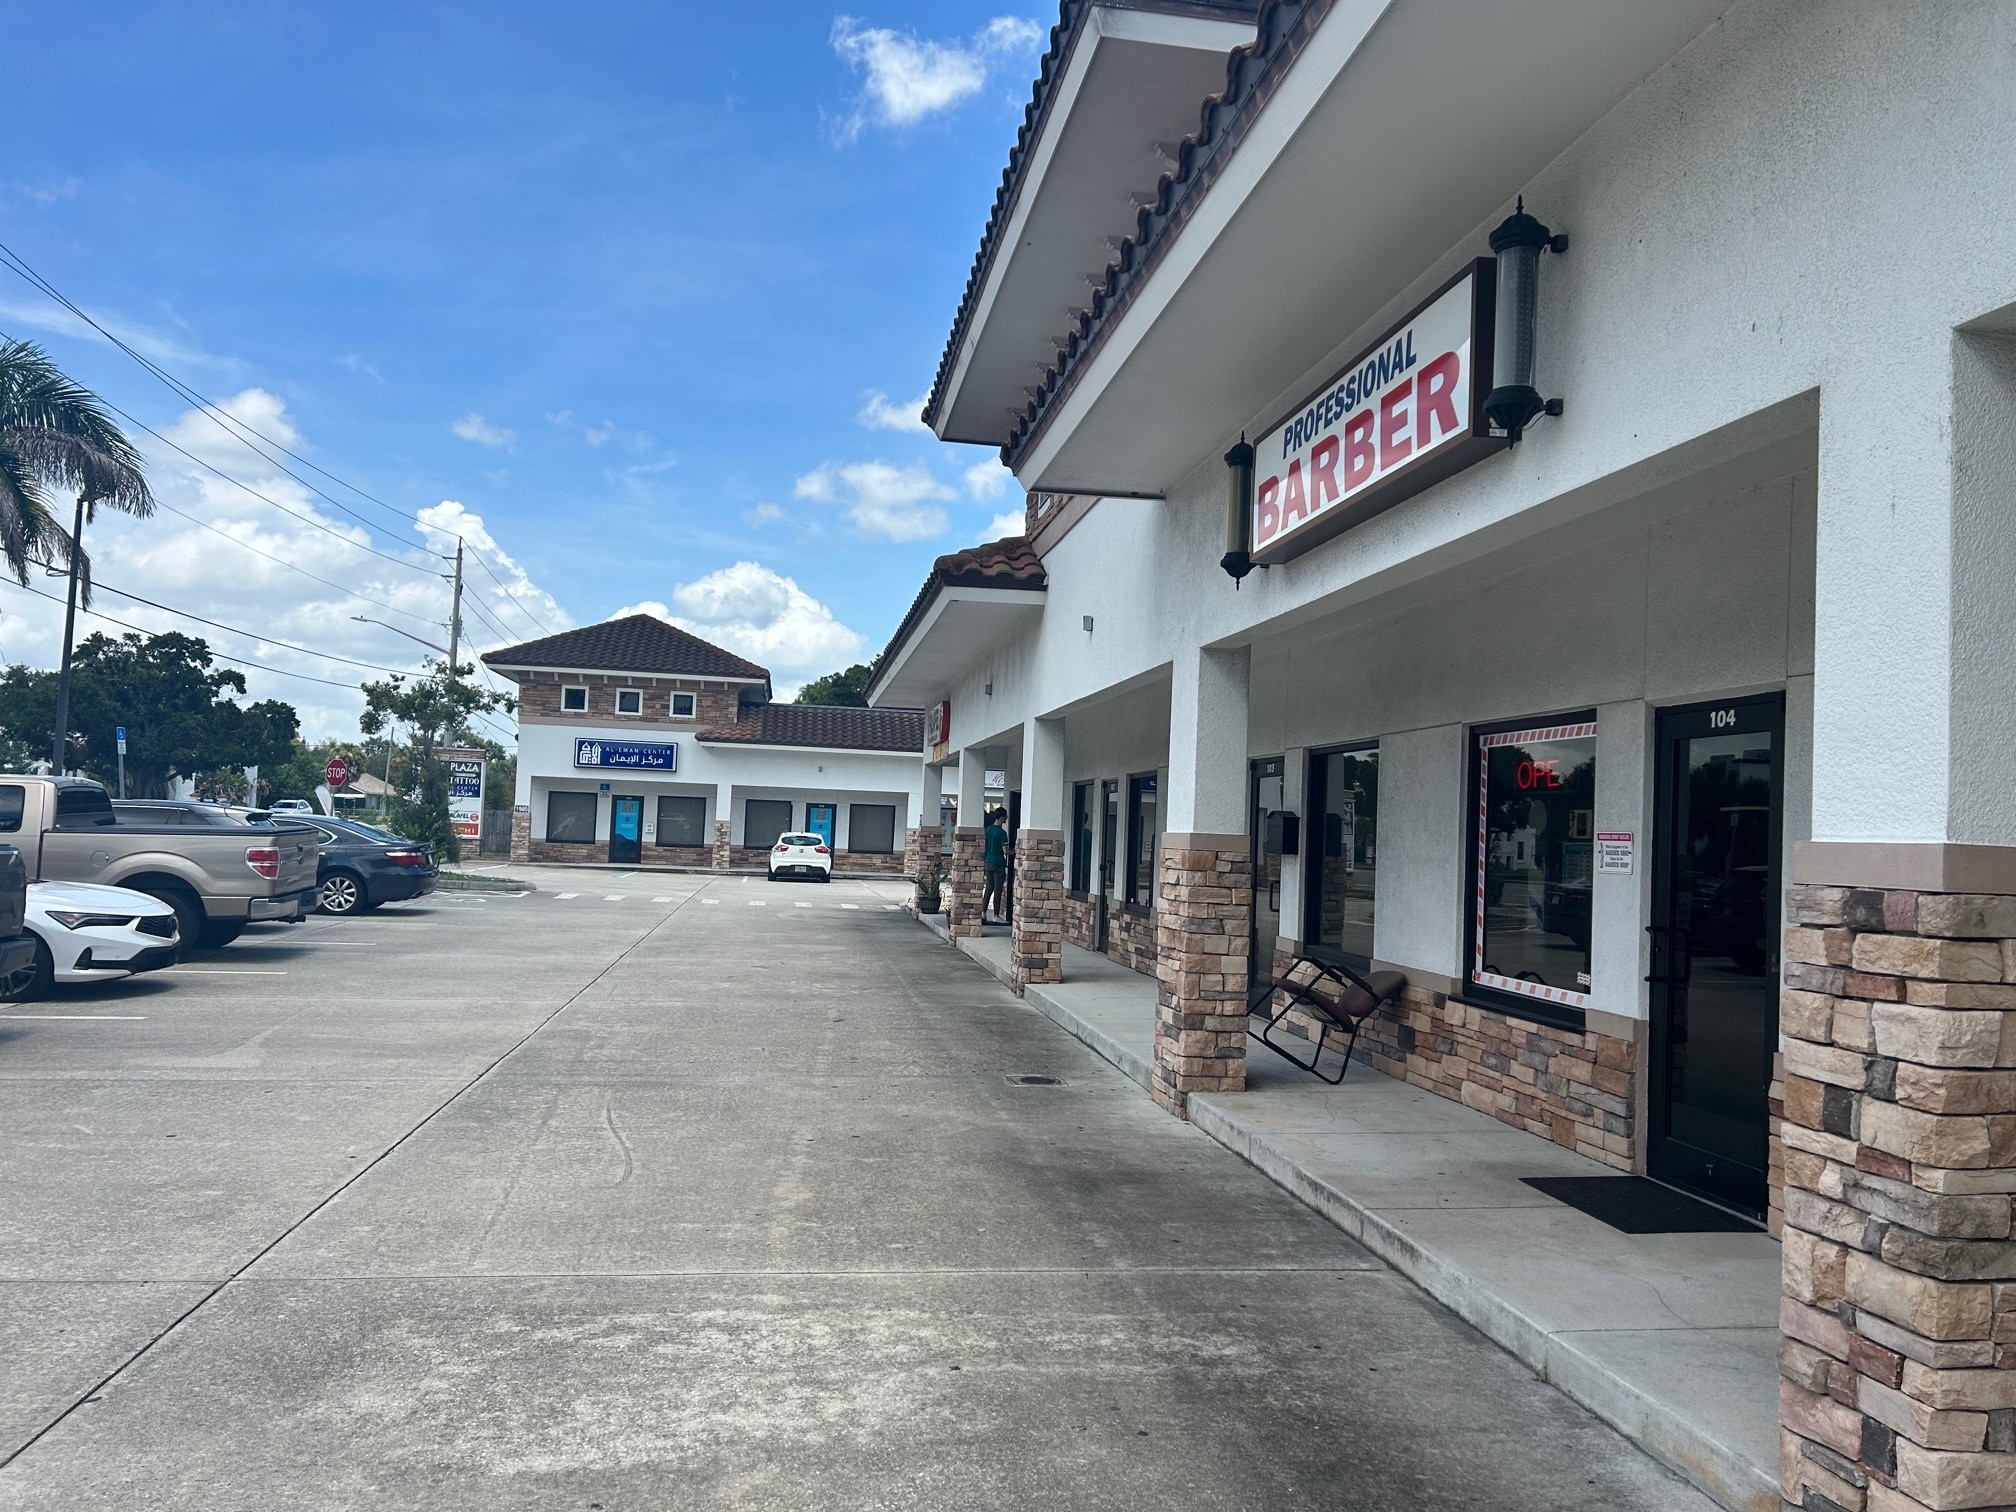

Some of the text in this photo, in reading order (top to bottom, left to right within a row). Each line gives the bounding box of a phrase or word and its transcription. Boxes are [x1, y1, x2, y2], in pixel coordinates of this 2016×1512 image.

[1283, 329, 1417, 459] PROFESSIONAL
[1257, 351, 1460, 545] BARBER
[1710, 709, 1736, 728] 104
[605, 746, 639, 754] AL-EMAN
[609, 753, 664, 765] مركز الإيمان
[327, 767, 346, 778] STOP
[450, 762, 479, 772] PLAZA
[1266, 763, 1275, 774] 103
[449, 776, 480, 785] TATTOO
